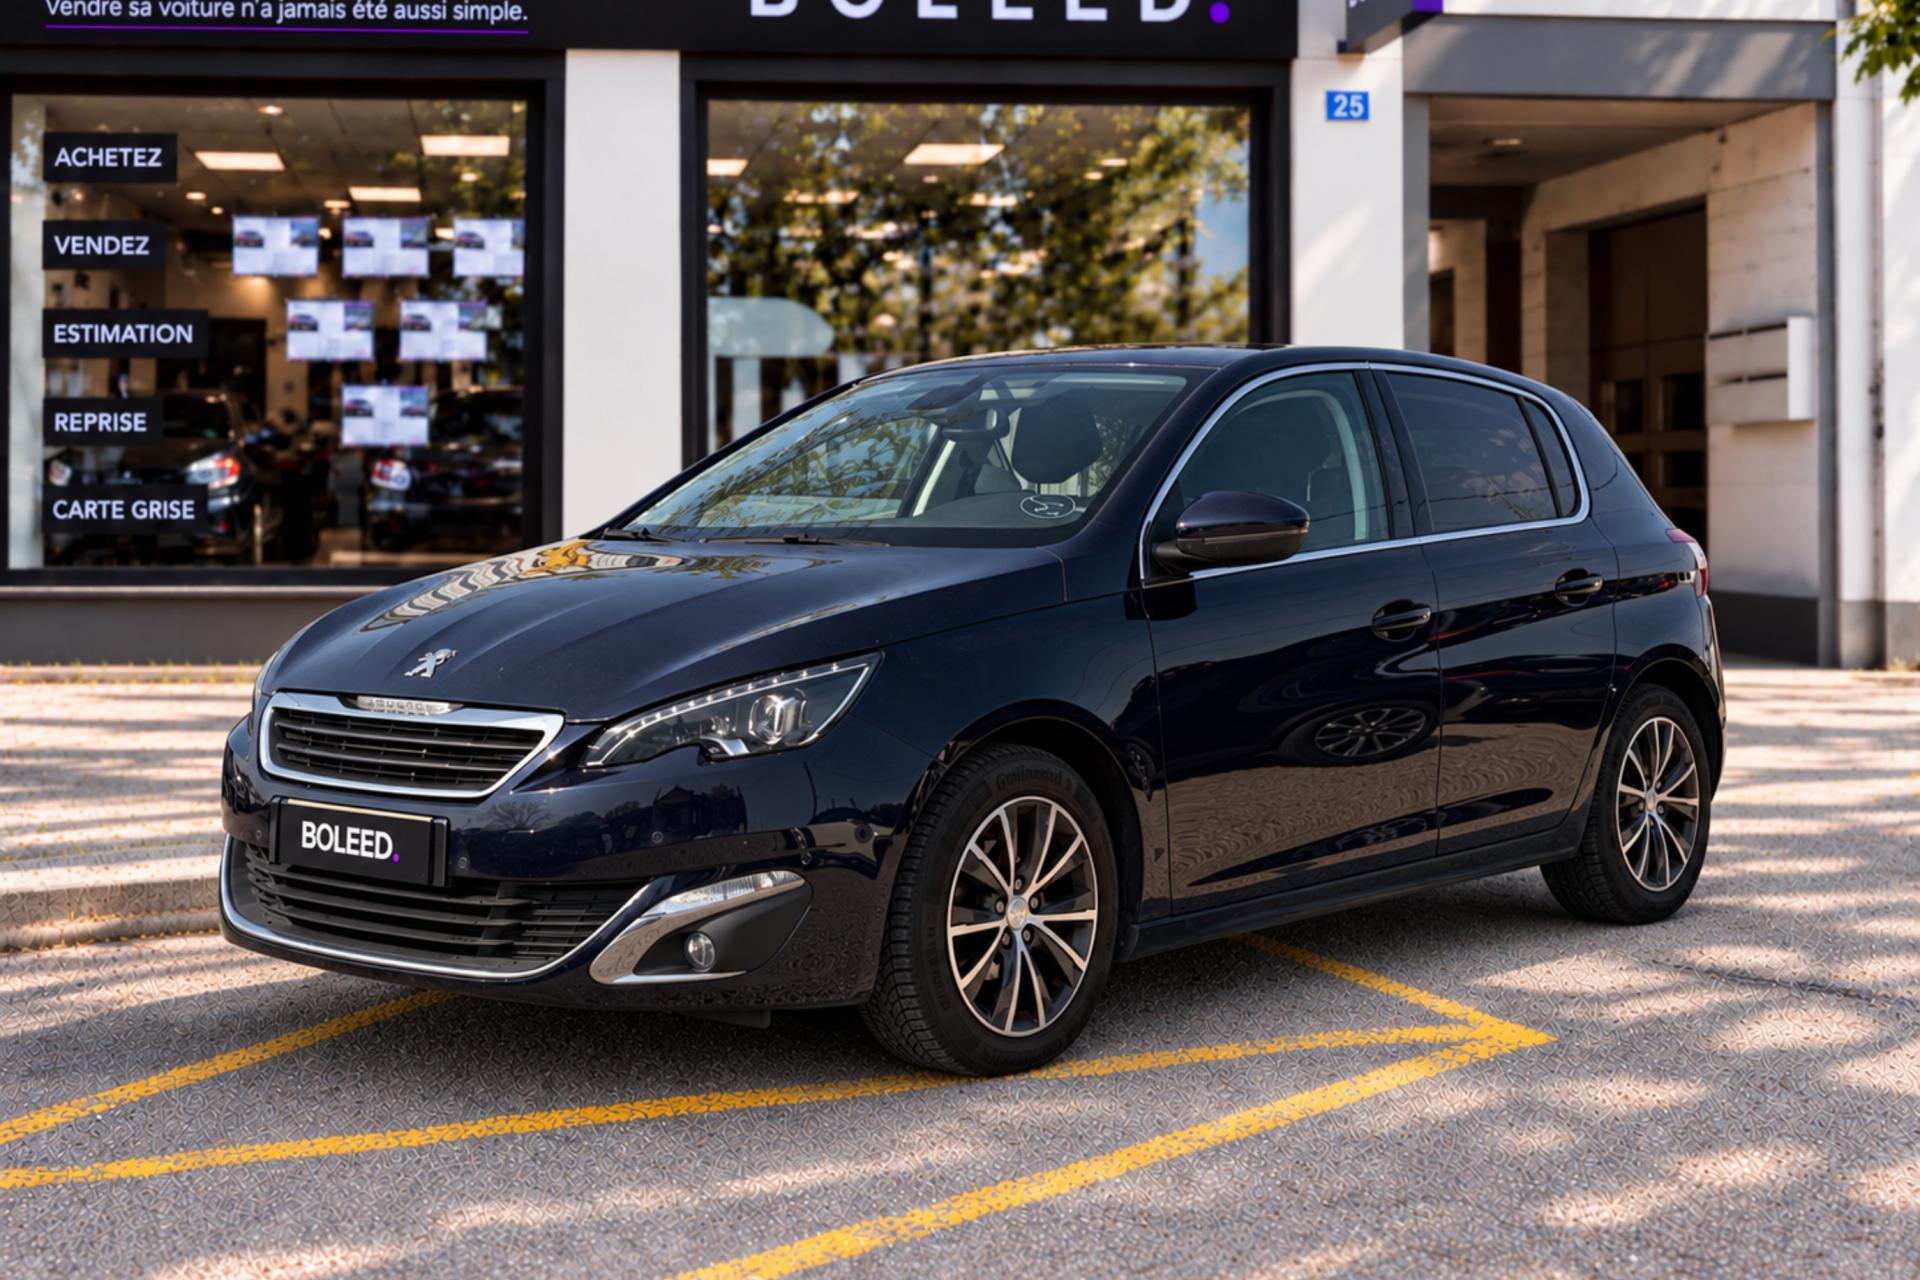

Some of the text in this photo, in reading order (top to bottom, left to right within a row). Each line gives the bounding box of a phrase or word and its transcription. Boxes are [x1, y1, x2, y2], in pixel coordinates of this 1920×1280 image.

[46, 0, 527, 25] Vendre sa voiture n'a jamais été aussi simple.
[1334, 94, 1364, 118] 25
[54, 147, 162, 167] ACHETEZ
[54, 235, 149, 255] VENDEZ
[54, 323, 193, 344] ESTIMATION
[55, 412, 147, 432] REPRISE
[53, 500, 195, 520] CARTE GRISE
[301, 820, 400, 863] BOLEED.
